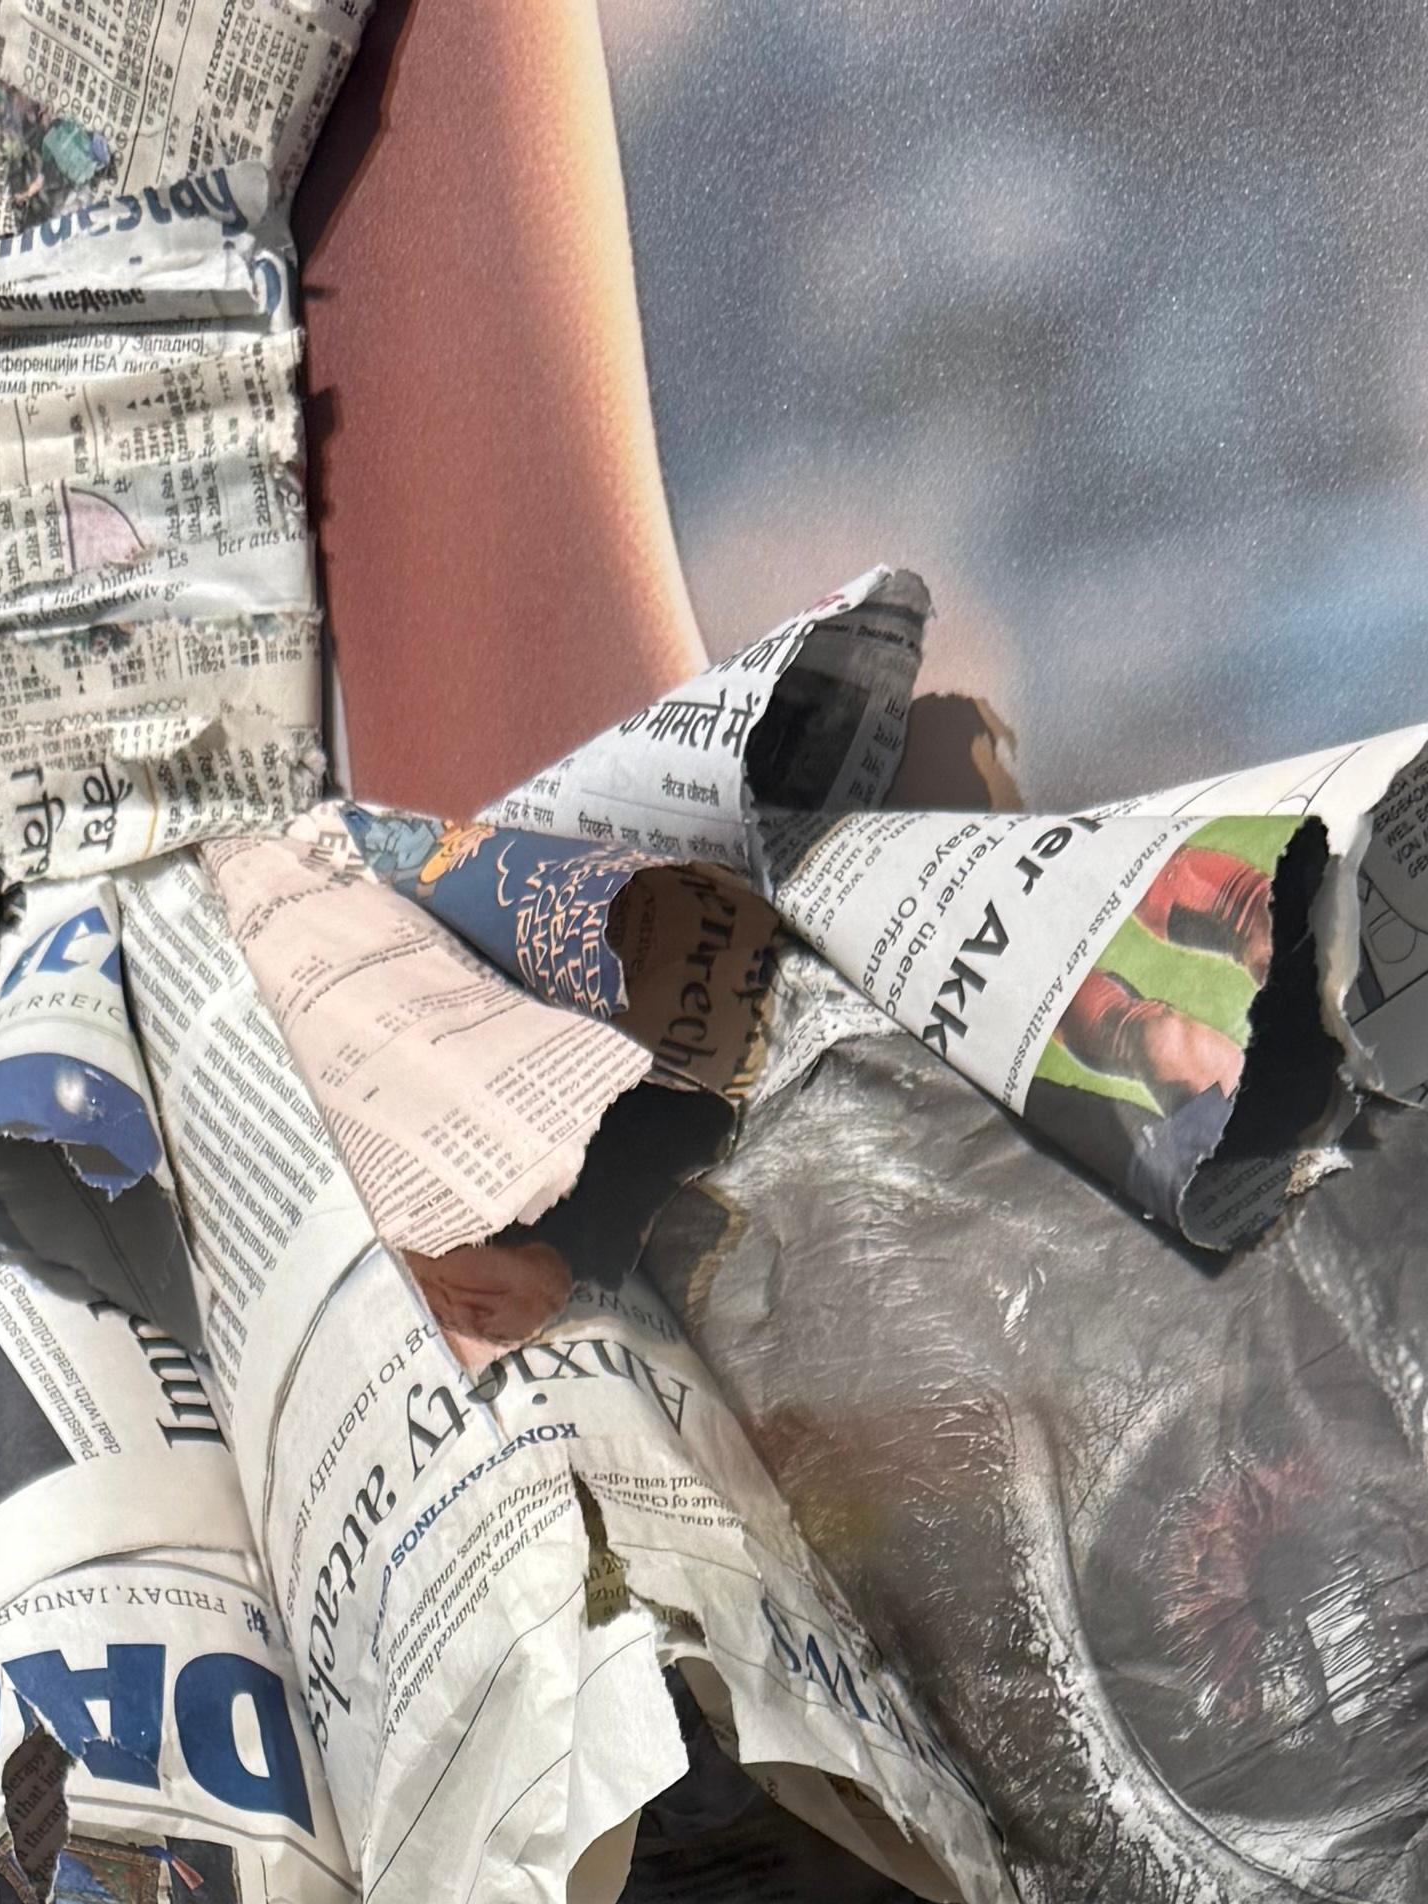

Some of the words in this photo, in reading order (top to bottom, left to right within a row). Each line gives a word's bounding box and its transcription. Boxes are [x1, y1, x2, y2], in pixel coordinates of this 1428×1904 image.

[916, 824, 979, 892] Bayer
[1391, 837, 1423, 866] VON
[935, 834, 1003, 918] Terrier
[914, 902, 1009, 1062] Akk
[14, 1334, 37, 1362] the
[28, 1355, 48, 1377] in
[45, 1344, 83, 1389] Israel
[378, 1351, 406, 1385] to
[37, 1372, 100, 1462] Palestinians
[73, 1384, 102, 1423] with
[90, 1419, 123, 1455] deal
[308, 1382, 379, 1502] identify
[115, 1585, 228, 1615] FRIDAY,
